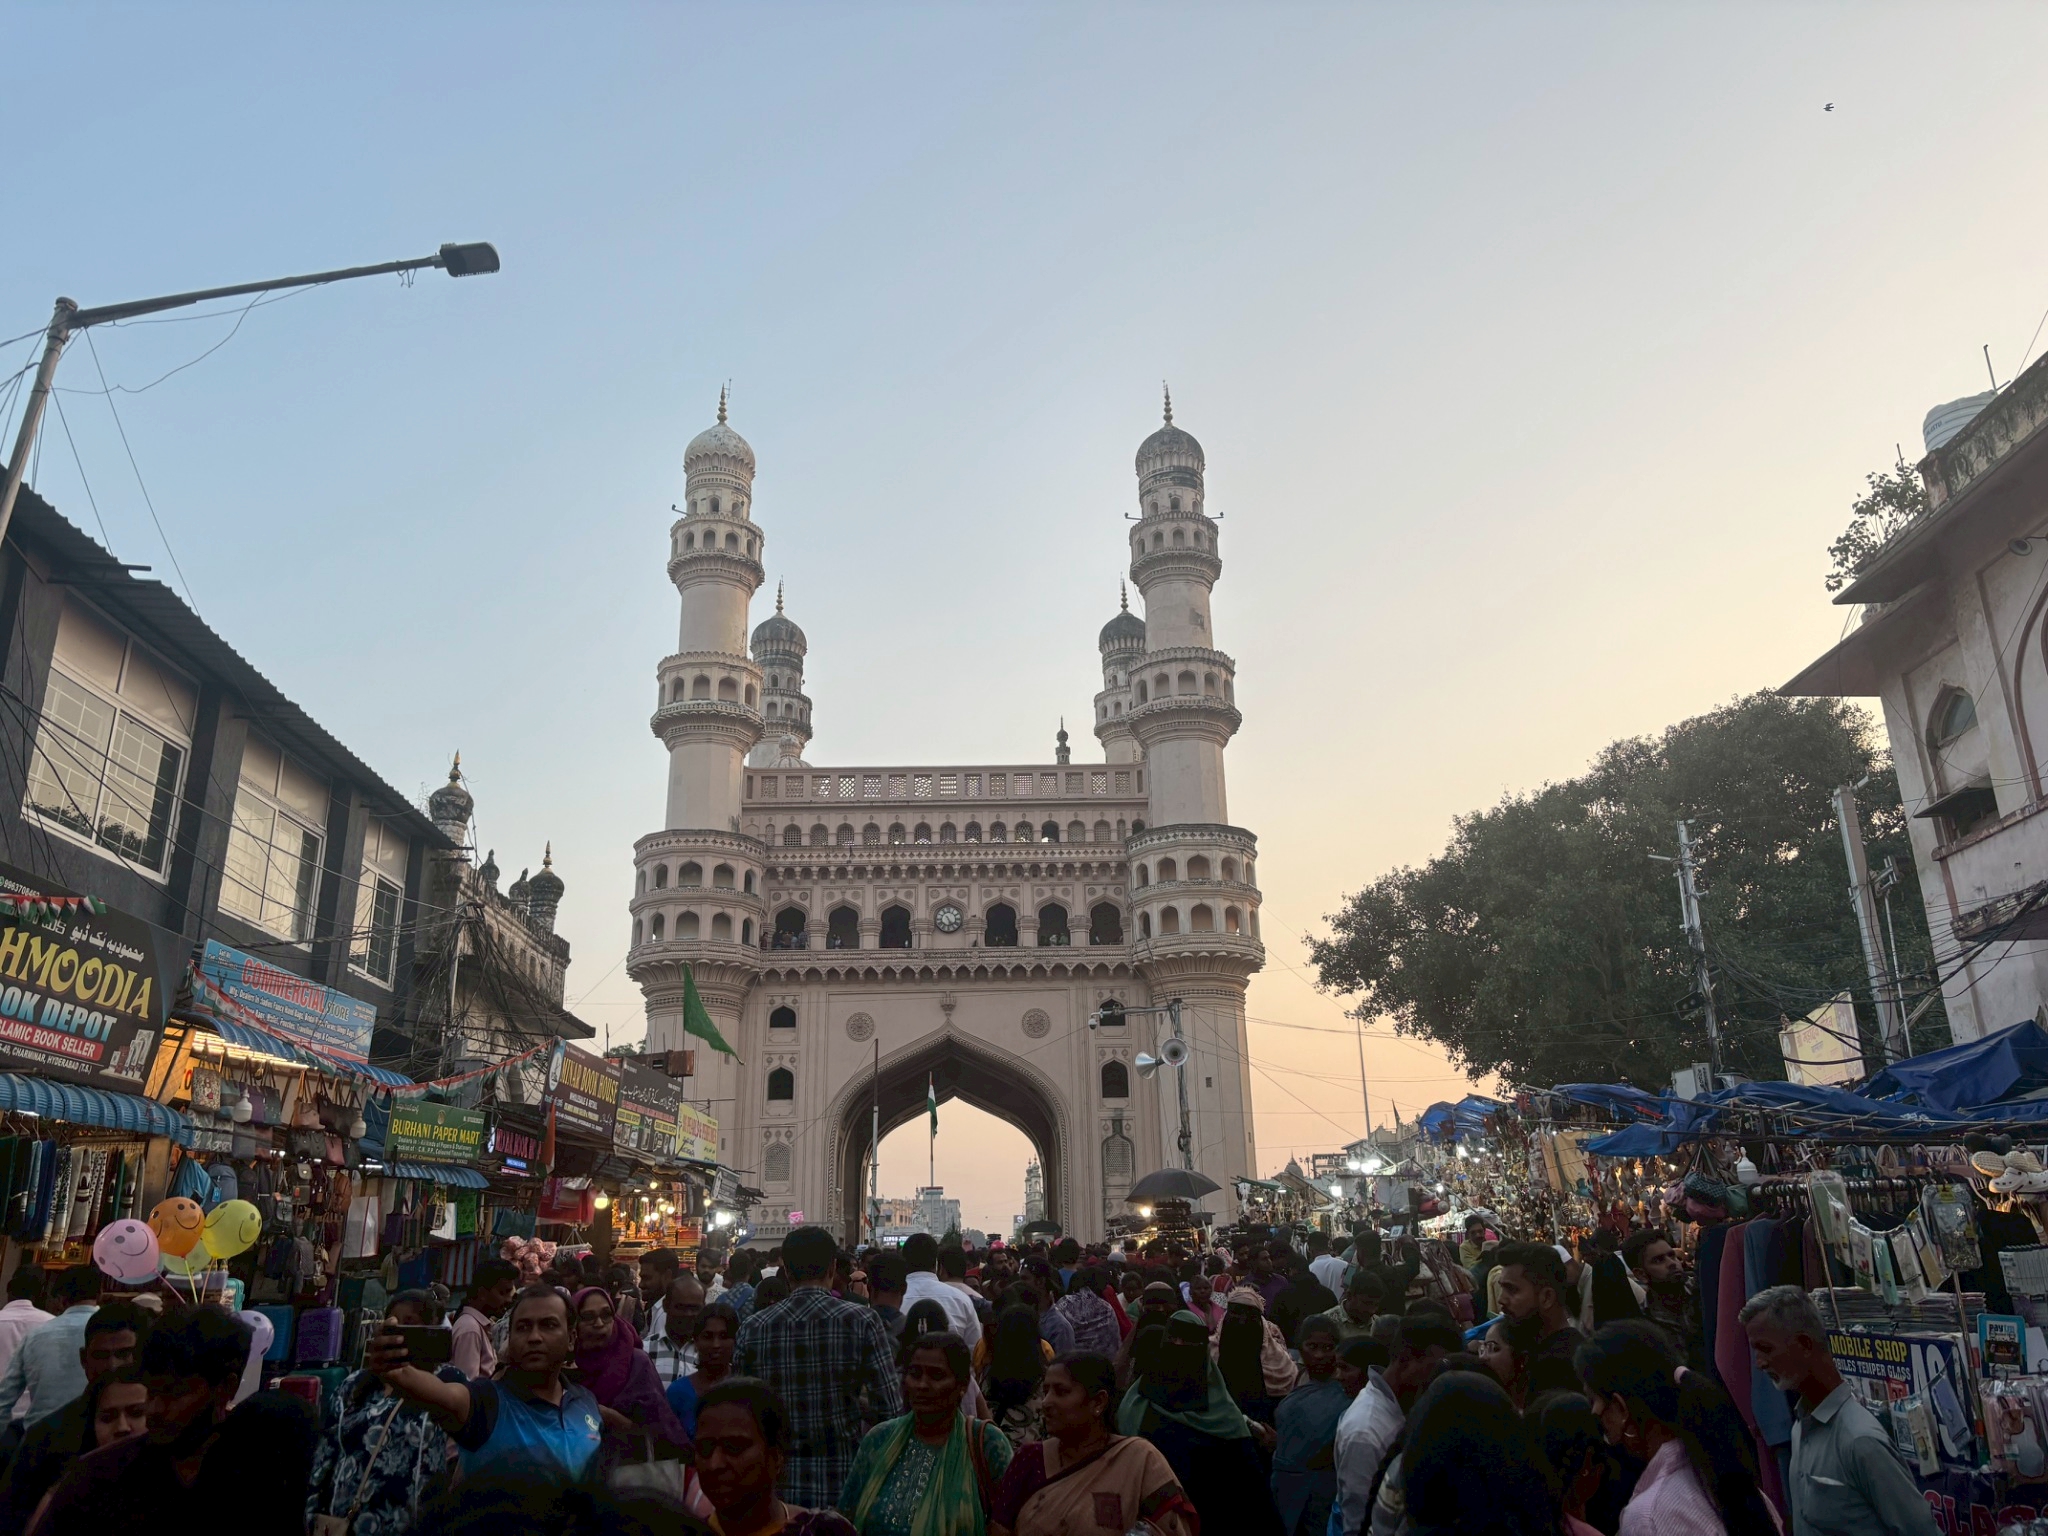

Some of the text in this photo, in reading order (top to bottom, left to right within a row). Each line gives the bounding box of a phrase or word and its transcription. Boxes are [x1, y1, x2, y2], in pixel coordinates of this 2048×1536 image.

[0, 926, 152, 1020] HMOODIA
[241, 957, 327, 1017] COMMERCIAL
[325, 1000, 350, 1022] STORE
[0, 982, 118, 1043] OK DEPOT
[32, 1028, 63, 1050] BOOK
[62, 1036, 96, 1058] SELLER
[46, 1055, 80, 1071] HYDERABAD
[561, 1056, 582, 1090] MINAR
[580, 1065, 600, 1099] BOOK
[597, 1073, 620, 1105] HOUSE
[391, 1118, 481, 1146] BURHANI PAPER MART
[1829, 1334, 1908, 1363] MOBILE SHOP
[1832, 1357, 1912, 1382] OBILES TEMPER GLASS
[1924, 1489, 2048, 1536] GLA
